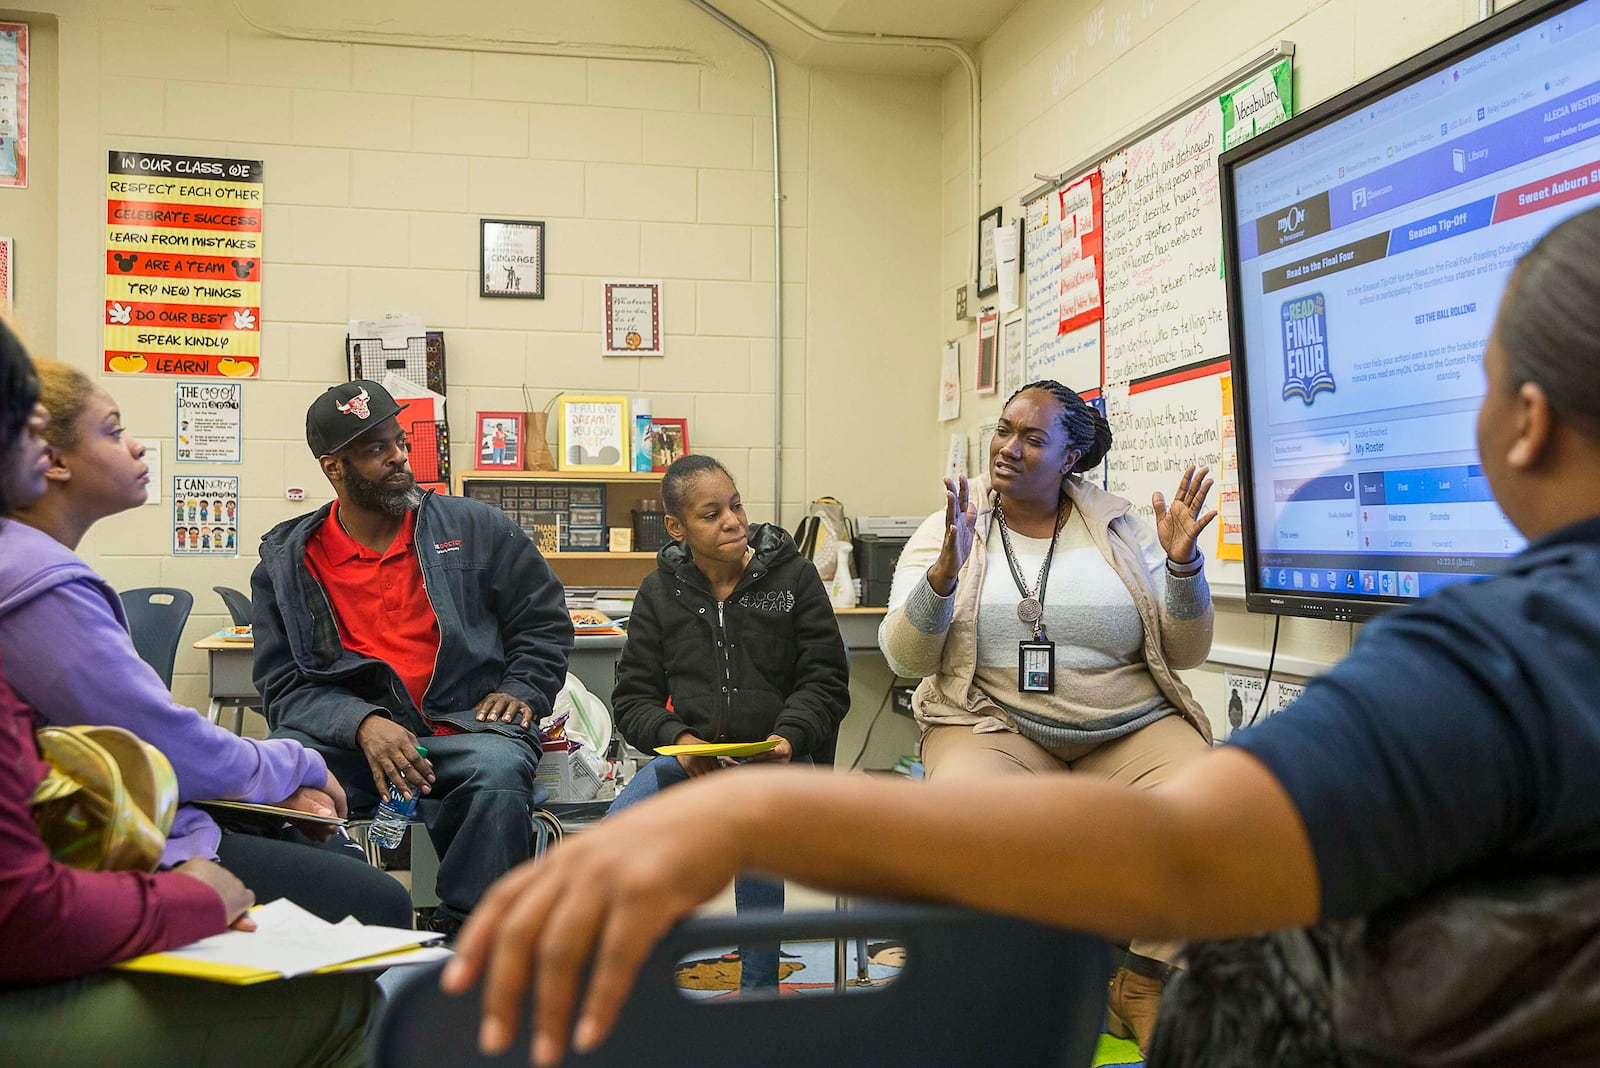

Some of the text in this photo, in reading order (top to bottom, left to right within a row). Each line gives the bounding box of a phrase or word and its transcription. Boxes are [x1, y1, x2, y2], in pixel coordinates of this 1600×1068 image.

[1544, 105, 1570, 123] ALECIA
[1135, 162, 1160, 190] identify
[1162, 156, 1174, 174] and
[1176, 131, 1215, 166] distinguish
[1468, 148, 1489, 162] Library
[122, 157, 250, 177] IN OUR CLASS, WE
[1156, 181, 1172, 199] third
[1174, 170, 1192, 190] person
[1195, 151, 1211, 178] point
[110, 181, 259, 200] RESPECT EACH OTHER
[1519, 176, 1588, 206] Sweet Auburn
[1143, 200, 1171, 224] describe
[1174, 189, 1191, 207] how
[114, 209, 257, 226] CELEBRATE SUCCESS
[1175, 207, 1192, 232] point
[1278, 206, 1305, 232] myON
[1408, 212, 1467, 240] Season Tip-Off
[110, 232, 256, 249] LEARN FROM MISTAKES
[1170, 226, 1203, 248] events are
[145, 259, 225, 273] ARE A TEAM
[491, 254, 534, 263] COURAGE
[1286, 251, 1355, 280] Read to the Final Four
[1362, 249, 1497, 293] Season Tip-Off for the Read to the Final Four Reading
[1413, 282, 1423, 292] The
[1424, 276, 1444, 290] contest
[1444, 274, 1455, 284] has
[1455, 268, 1475, 281] started
[1476, 264, 1487, 275] and
[1488, 262, 1497, 273] it's
[128, 282, 241, 298] TRY NEW THINGS
[1160, 274, 1187, 294] between
[1161, 300, 1180, 312] view
[1289, 299, 1314, 320] READ
[1415, 302, 1477, 325] GET THE BALL ROLLING!
[135, 310, 228, 324] DO OUR BEST
[1114, 306, 1223, 359] can identify is telling the
[1285, 314, 1323, 349] FINAL
[137, 334, 229, 349] SPEAK KINDLY
[1149, 335, 1204, 368] character traits
[1353, 343, 1456, 371] You help your school earn spot in the
[156, 358, 209, 373] LEARN!
[1288, 344, 1325, 378] FOUR
[1368, 352, 1482, 381] you read on Click on the Contest Page
[180, 386, 198, 398] THE
[179, 398, 208, 408] Down
[572, 415, 604, 424] DREAM
[1135, 410, 1164, 438] analyze
[1165, 404, 1177, 425] the
[1179, 404, 1198, 430] place
[572, 426, 613, 437] YOU CAN
[1121, 436, 1138, 451] value
[1140, 431, 1148, 450] of
[1150, 438, 1155, 450] a
[1157, 428, 1173, 454] digit
[1185, 435, 1191, 448] a
[1192, 419, 1220, 446] decimal
[1354, 428, 1388, 439] Books finished
[1355, 442, 1384, 454] My Roster
[1164, 453, 1183, 472] write
[176, 479, 181, 490] I
[184, 479, 205, 490] CAN
[1397, 483, 1408, 492] First
[1439, 481, 1450, 490] Last
[176, 492, 186, 500] my
[1430, 512, 1450, 521] Bounds
[748, 591, 786, 601] ROCA
[749, 601, 786, 612] WEAR
[1228, 677, 1262, 690] Voice Levels
[1278, 684, 1302, 698] Morning
